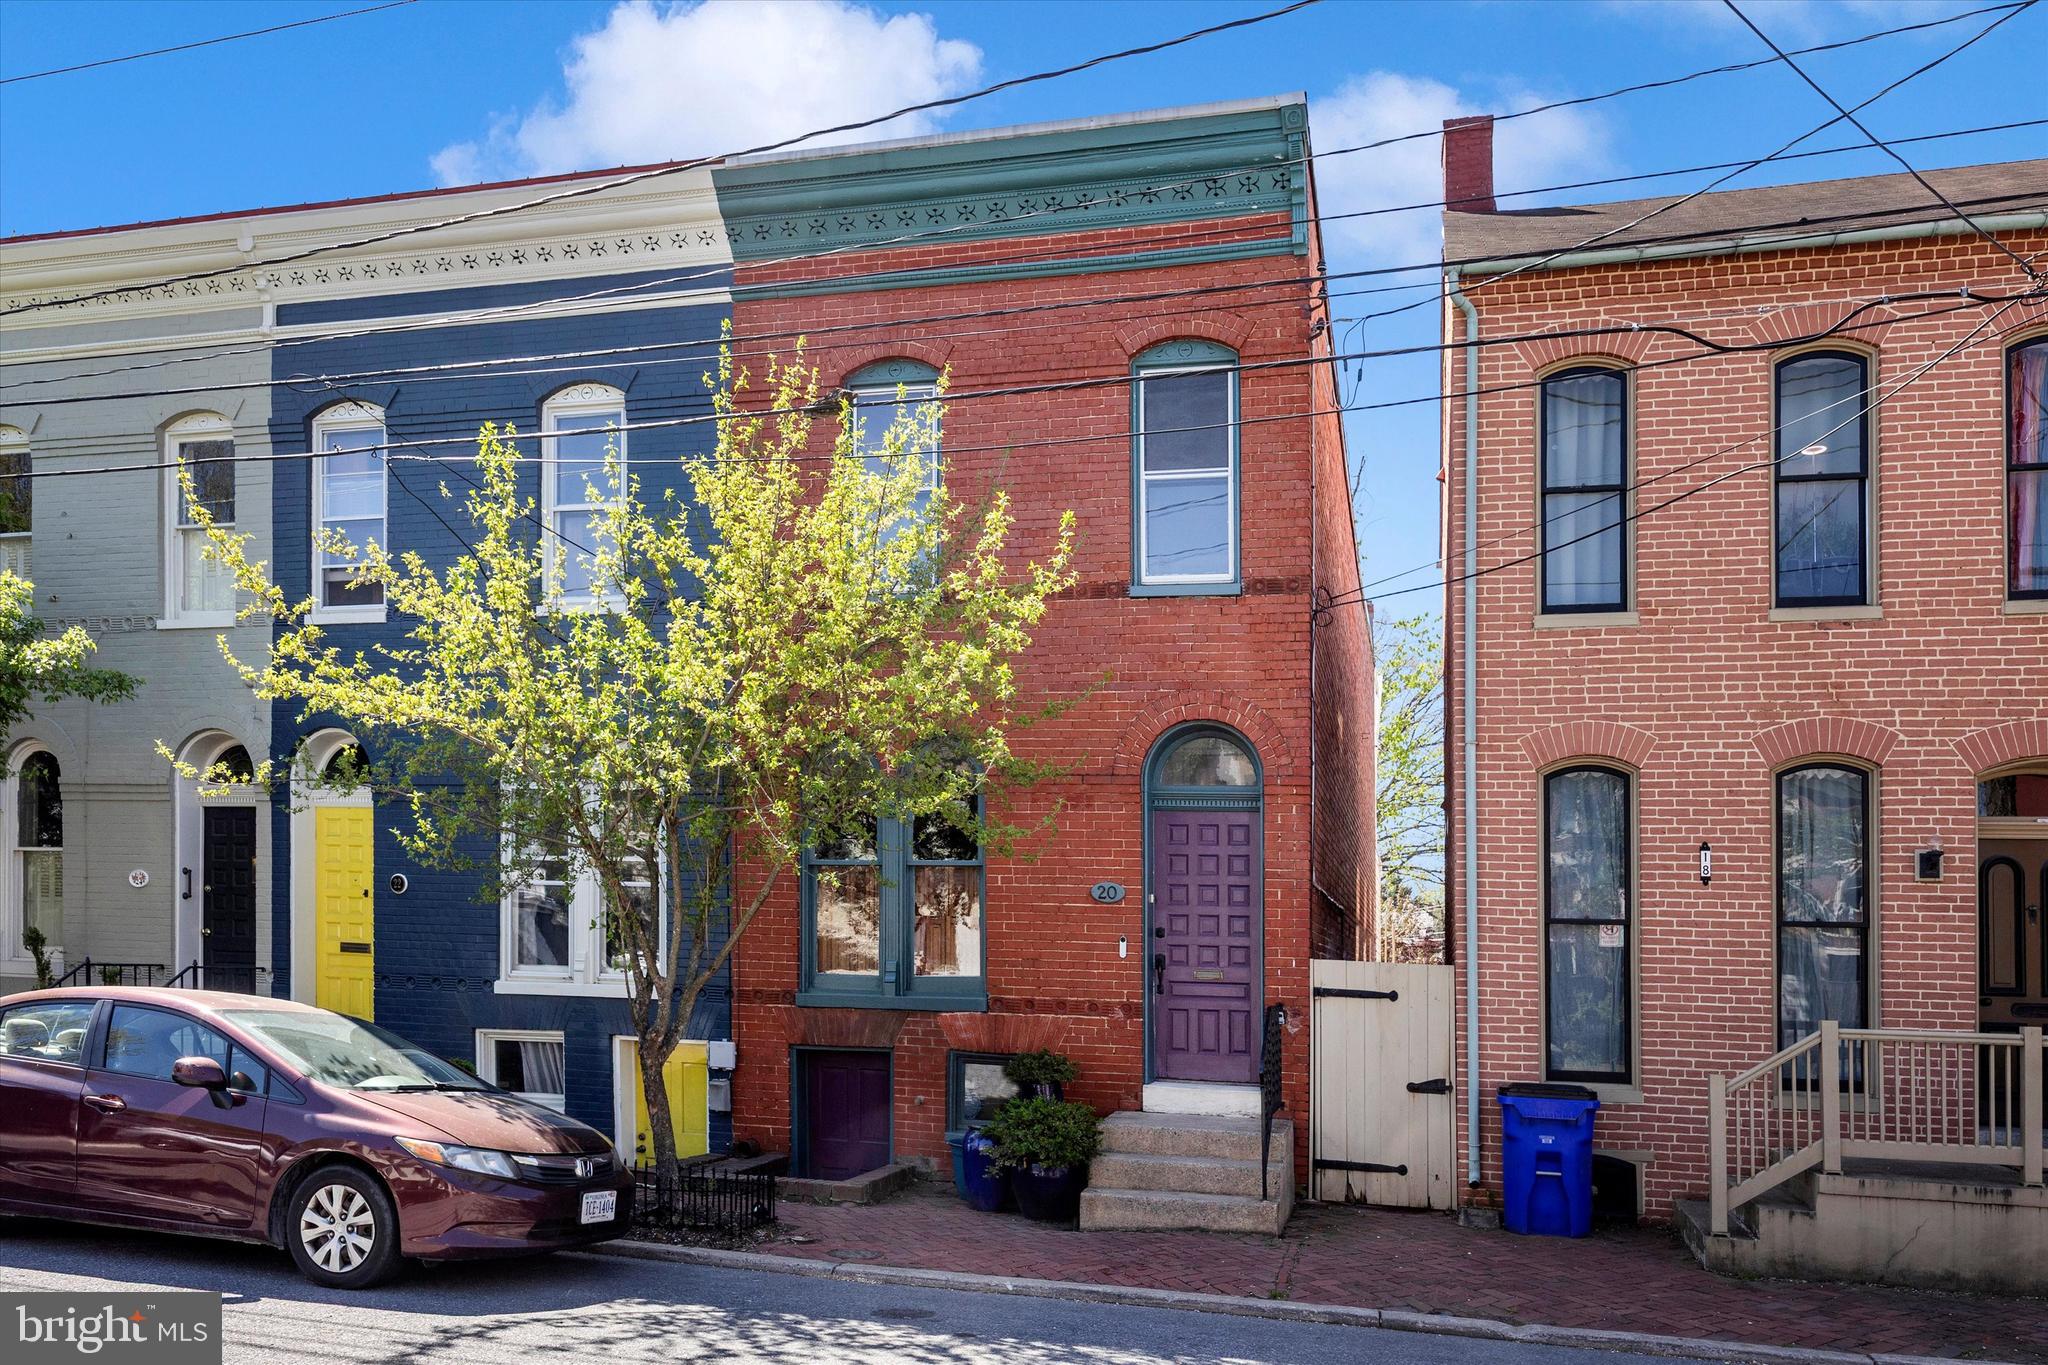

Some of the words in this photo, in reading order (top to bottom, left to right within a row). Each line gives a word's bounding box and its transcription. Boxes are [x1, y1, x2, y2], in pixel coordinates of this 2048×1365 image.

[1702, 852, 1710, 875] 18
[393, 878, 402, 889] 22
[1097, 885, 1118, 900] 20
